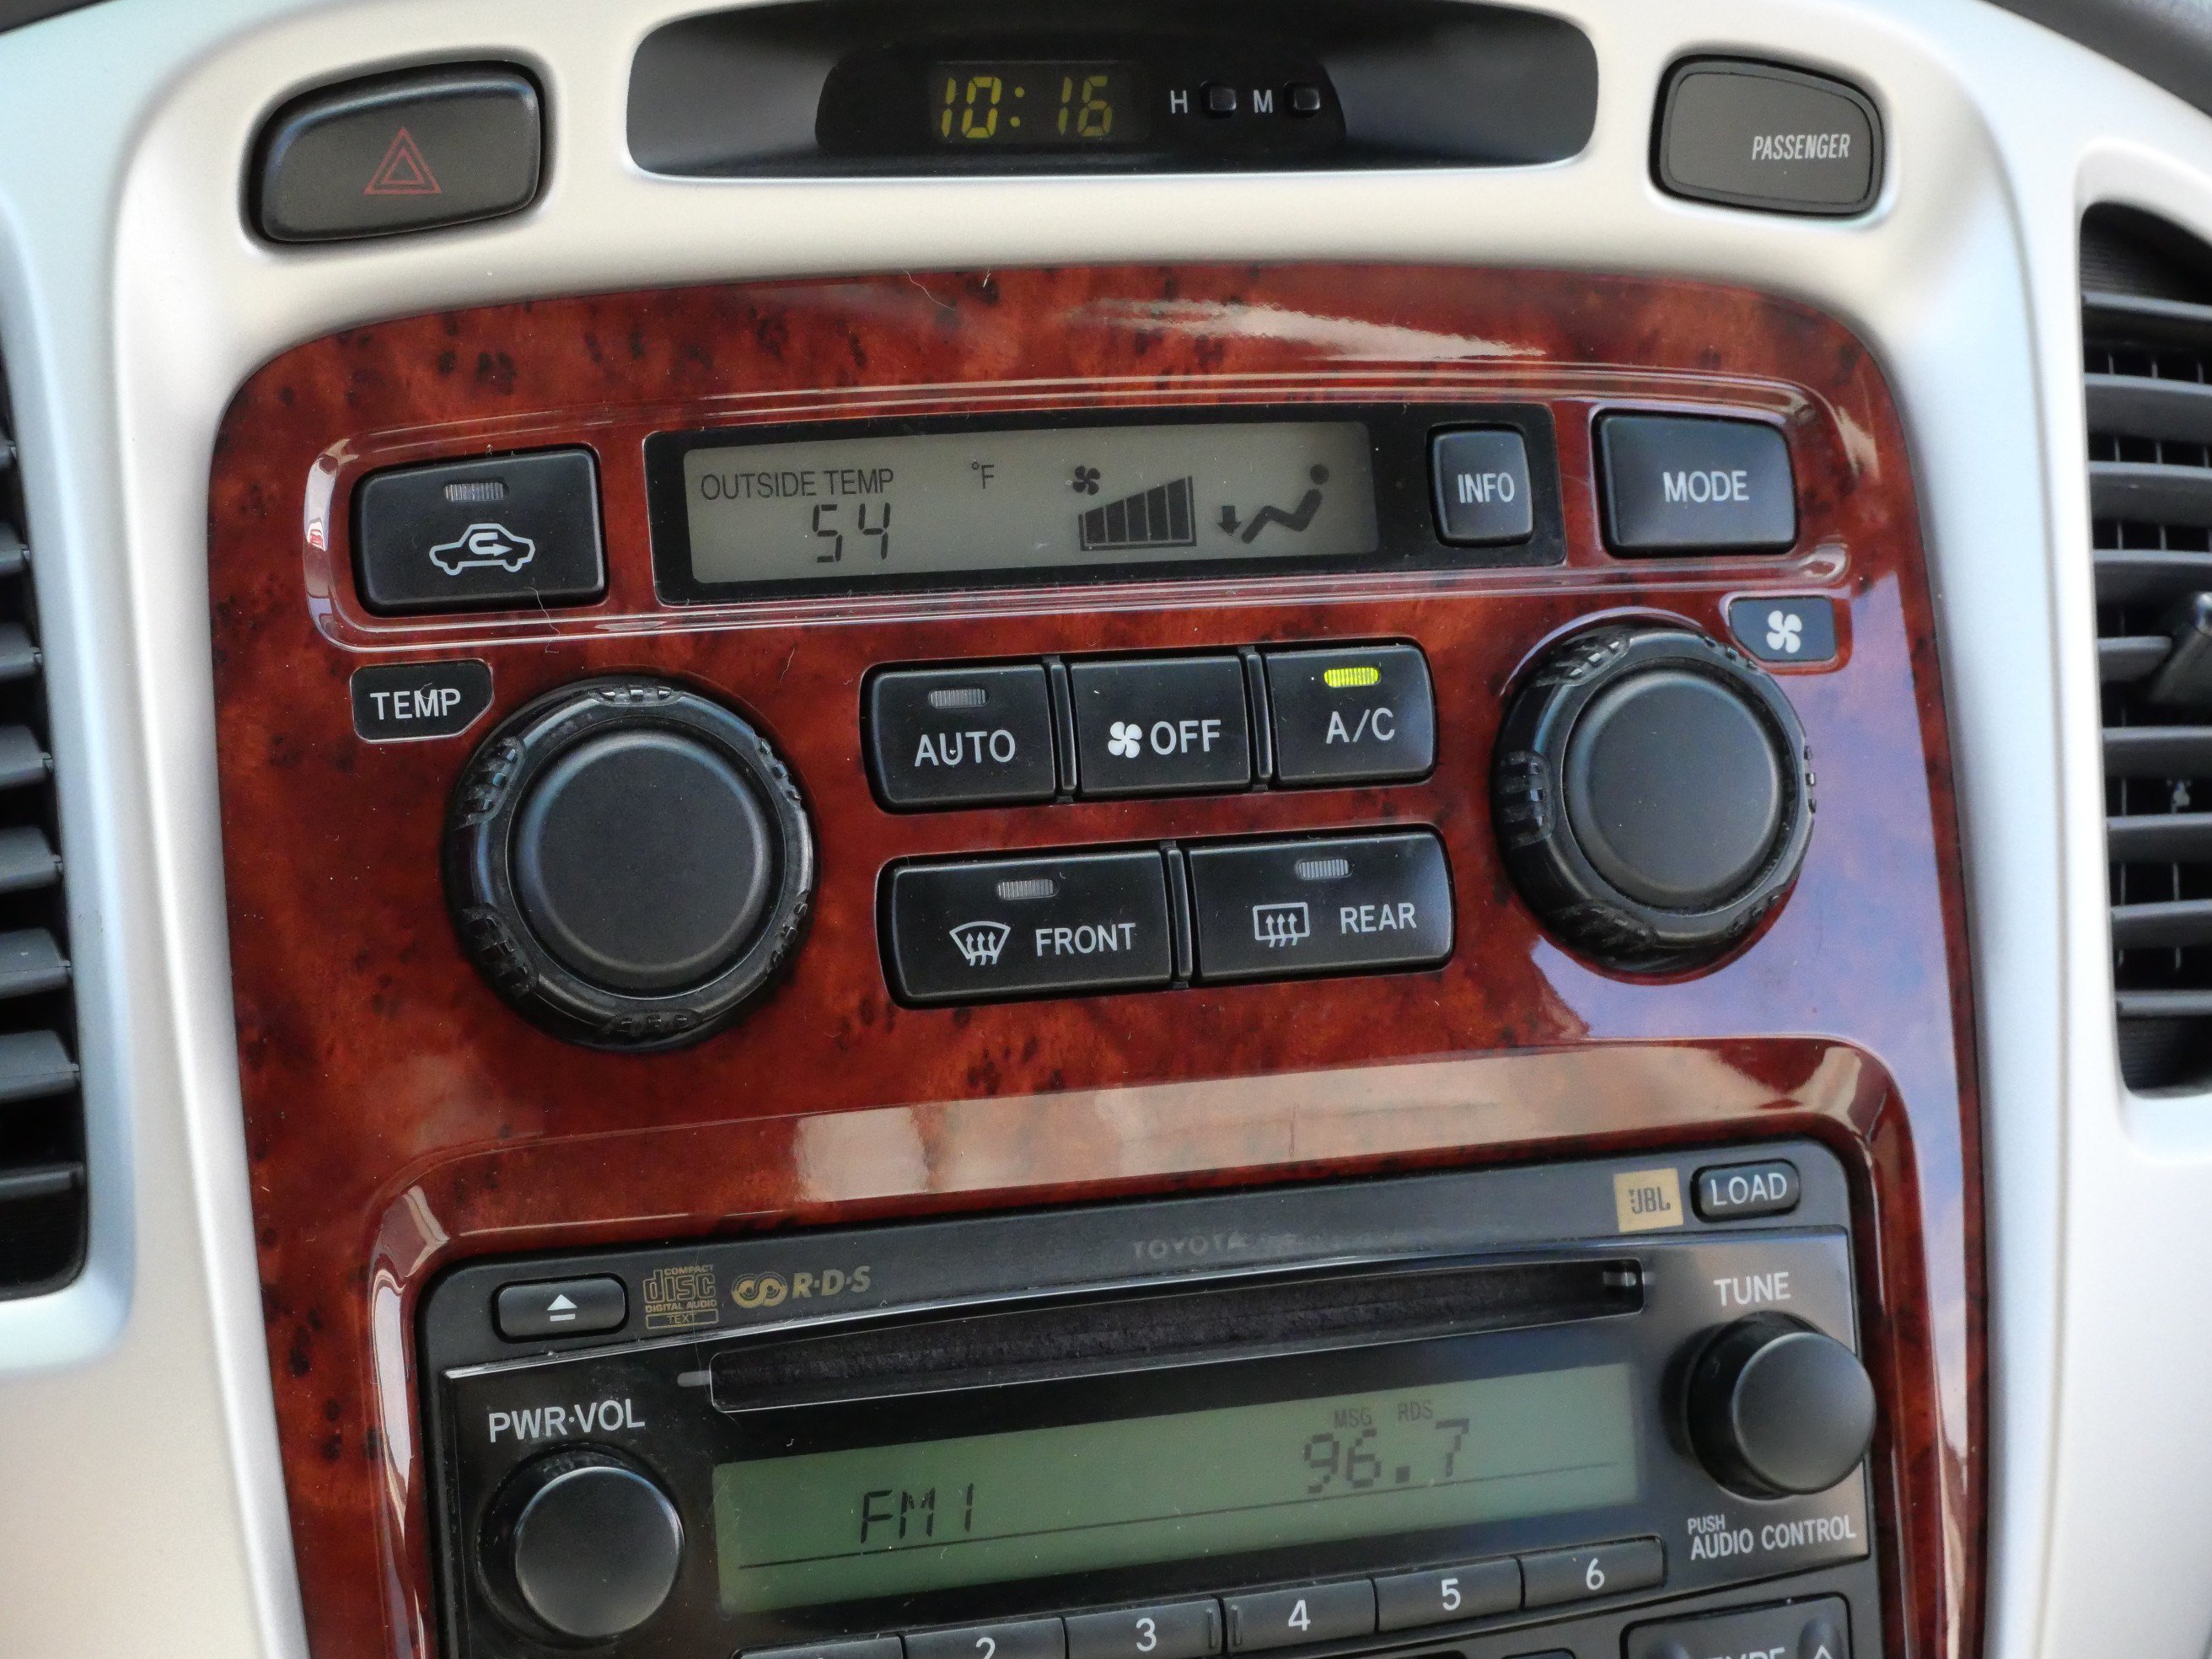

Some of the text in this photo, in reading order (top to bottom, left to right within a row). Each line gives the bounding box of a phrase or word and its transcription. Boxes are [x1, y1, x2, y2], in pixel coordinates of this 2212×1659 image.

[1169, 89, 1189, 114] H
[1253, 89, 1274, 114] M
[1752, 133, 1851, 160] PASSENGER
[701, 468, 894, 501] OUTSIDE TEMP
[1458, 472, 1516, 504] INFO
[1662, 470, 1750, 502] MODE
[812, 502, 891, 564] 54
[370, 688, 462, 721] TEMP
[1150, 719, 1222, 756] OFF
[1324, 707, 1396, 745] A/C
[914, 728, 1017, 767] AUTO
[1340, 902, 1418, 934] REAR
[1035, 922, 1137, 957] FRONT
[1629, 1186, 1672, 1216] JBL
[1710, 1172, 1788, 1207] LOAD
[1713, 1271, 1791, 1307] TUNE
[645, 1299, 717, 1313] DIGITAL AUDIO
[668, 1313, 697, 1324] TEXT
[1334, 1406, 1373, 1430] MSG
[1397, 1400, 1432, 1423] RDS
[1303, 1417, 1470, 1495] 96.7
[1687, 1514, 1726, 1536] PUSH
[1689, 1514, 1857, 1562] AUDIO CONTROL
[1586, 1557, 1606, 1591] 6
[1440, 1577, 1462, 1612] 5
[1286, 1598, 1312, 1632] 4
[1135, 1617, 1157, 1652] 3
